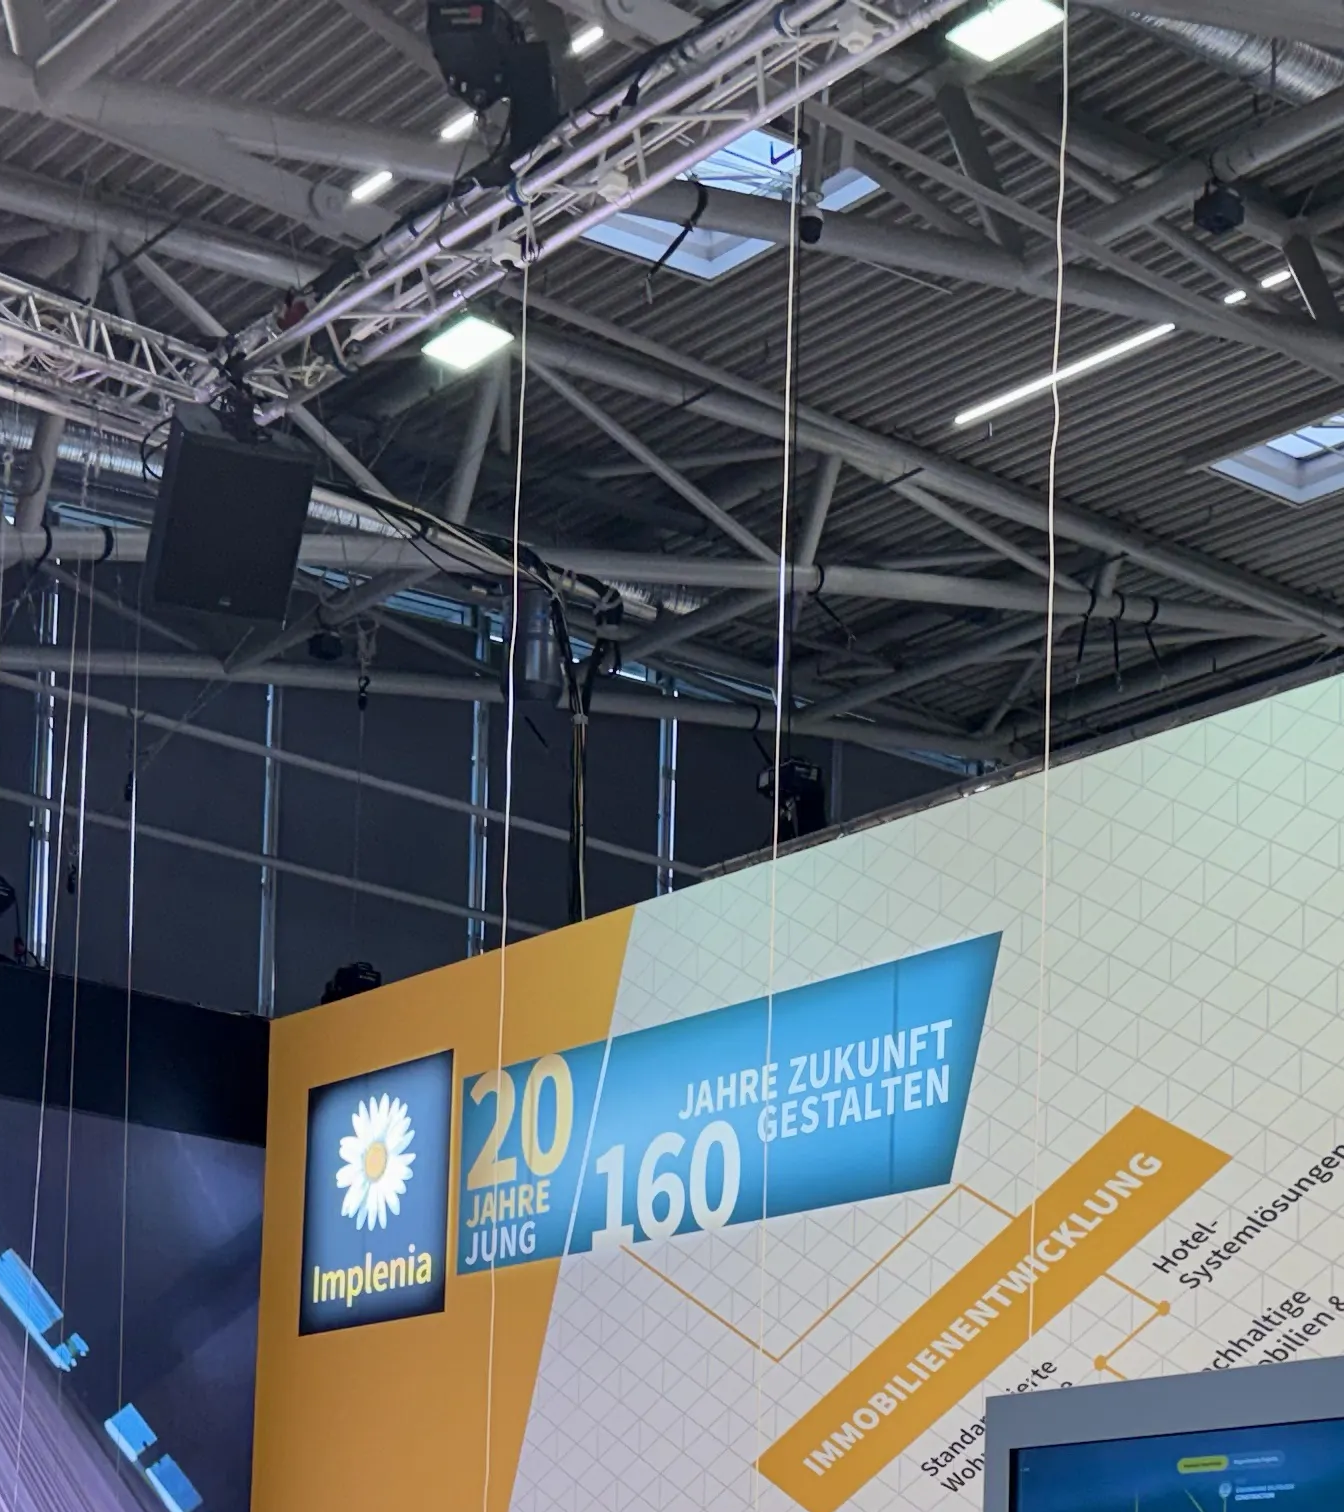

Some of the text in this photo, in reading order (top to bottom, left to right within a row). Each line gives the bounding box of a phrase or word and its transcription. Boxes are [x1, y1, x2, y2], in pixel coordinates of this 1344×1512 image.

[678, 1019, 952, 1119] JAHRE ZUKUNFT
[757, 1065, 949, 1142] GESTALTEN
[467, 1053, 573, 1190] 20
[466, 1180, 551, 1228] JAHRE
[591, 1120, 740, 1251] 160
[312, 1244, 432, 1307] Implenia
[465, 1221, 536, 1265] JUNG
[1152, 1220, 1219, 1274] Hotel-
[803, 1152, 1163, 1476] IMMOBILIENENTWICKLUNG
[1202, 1291, 1311, 1371] chhaltige
[1258, 1311, 1335, 1364] bilien
